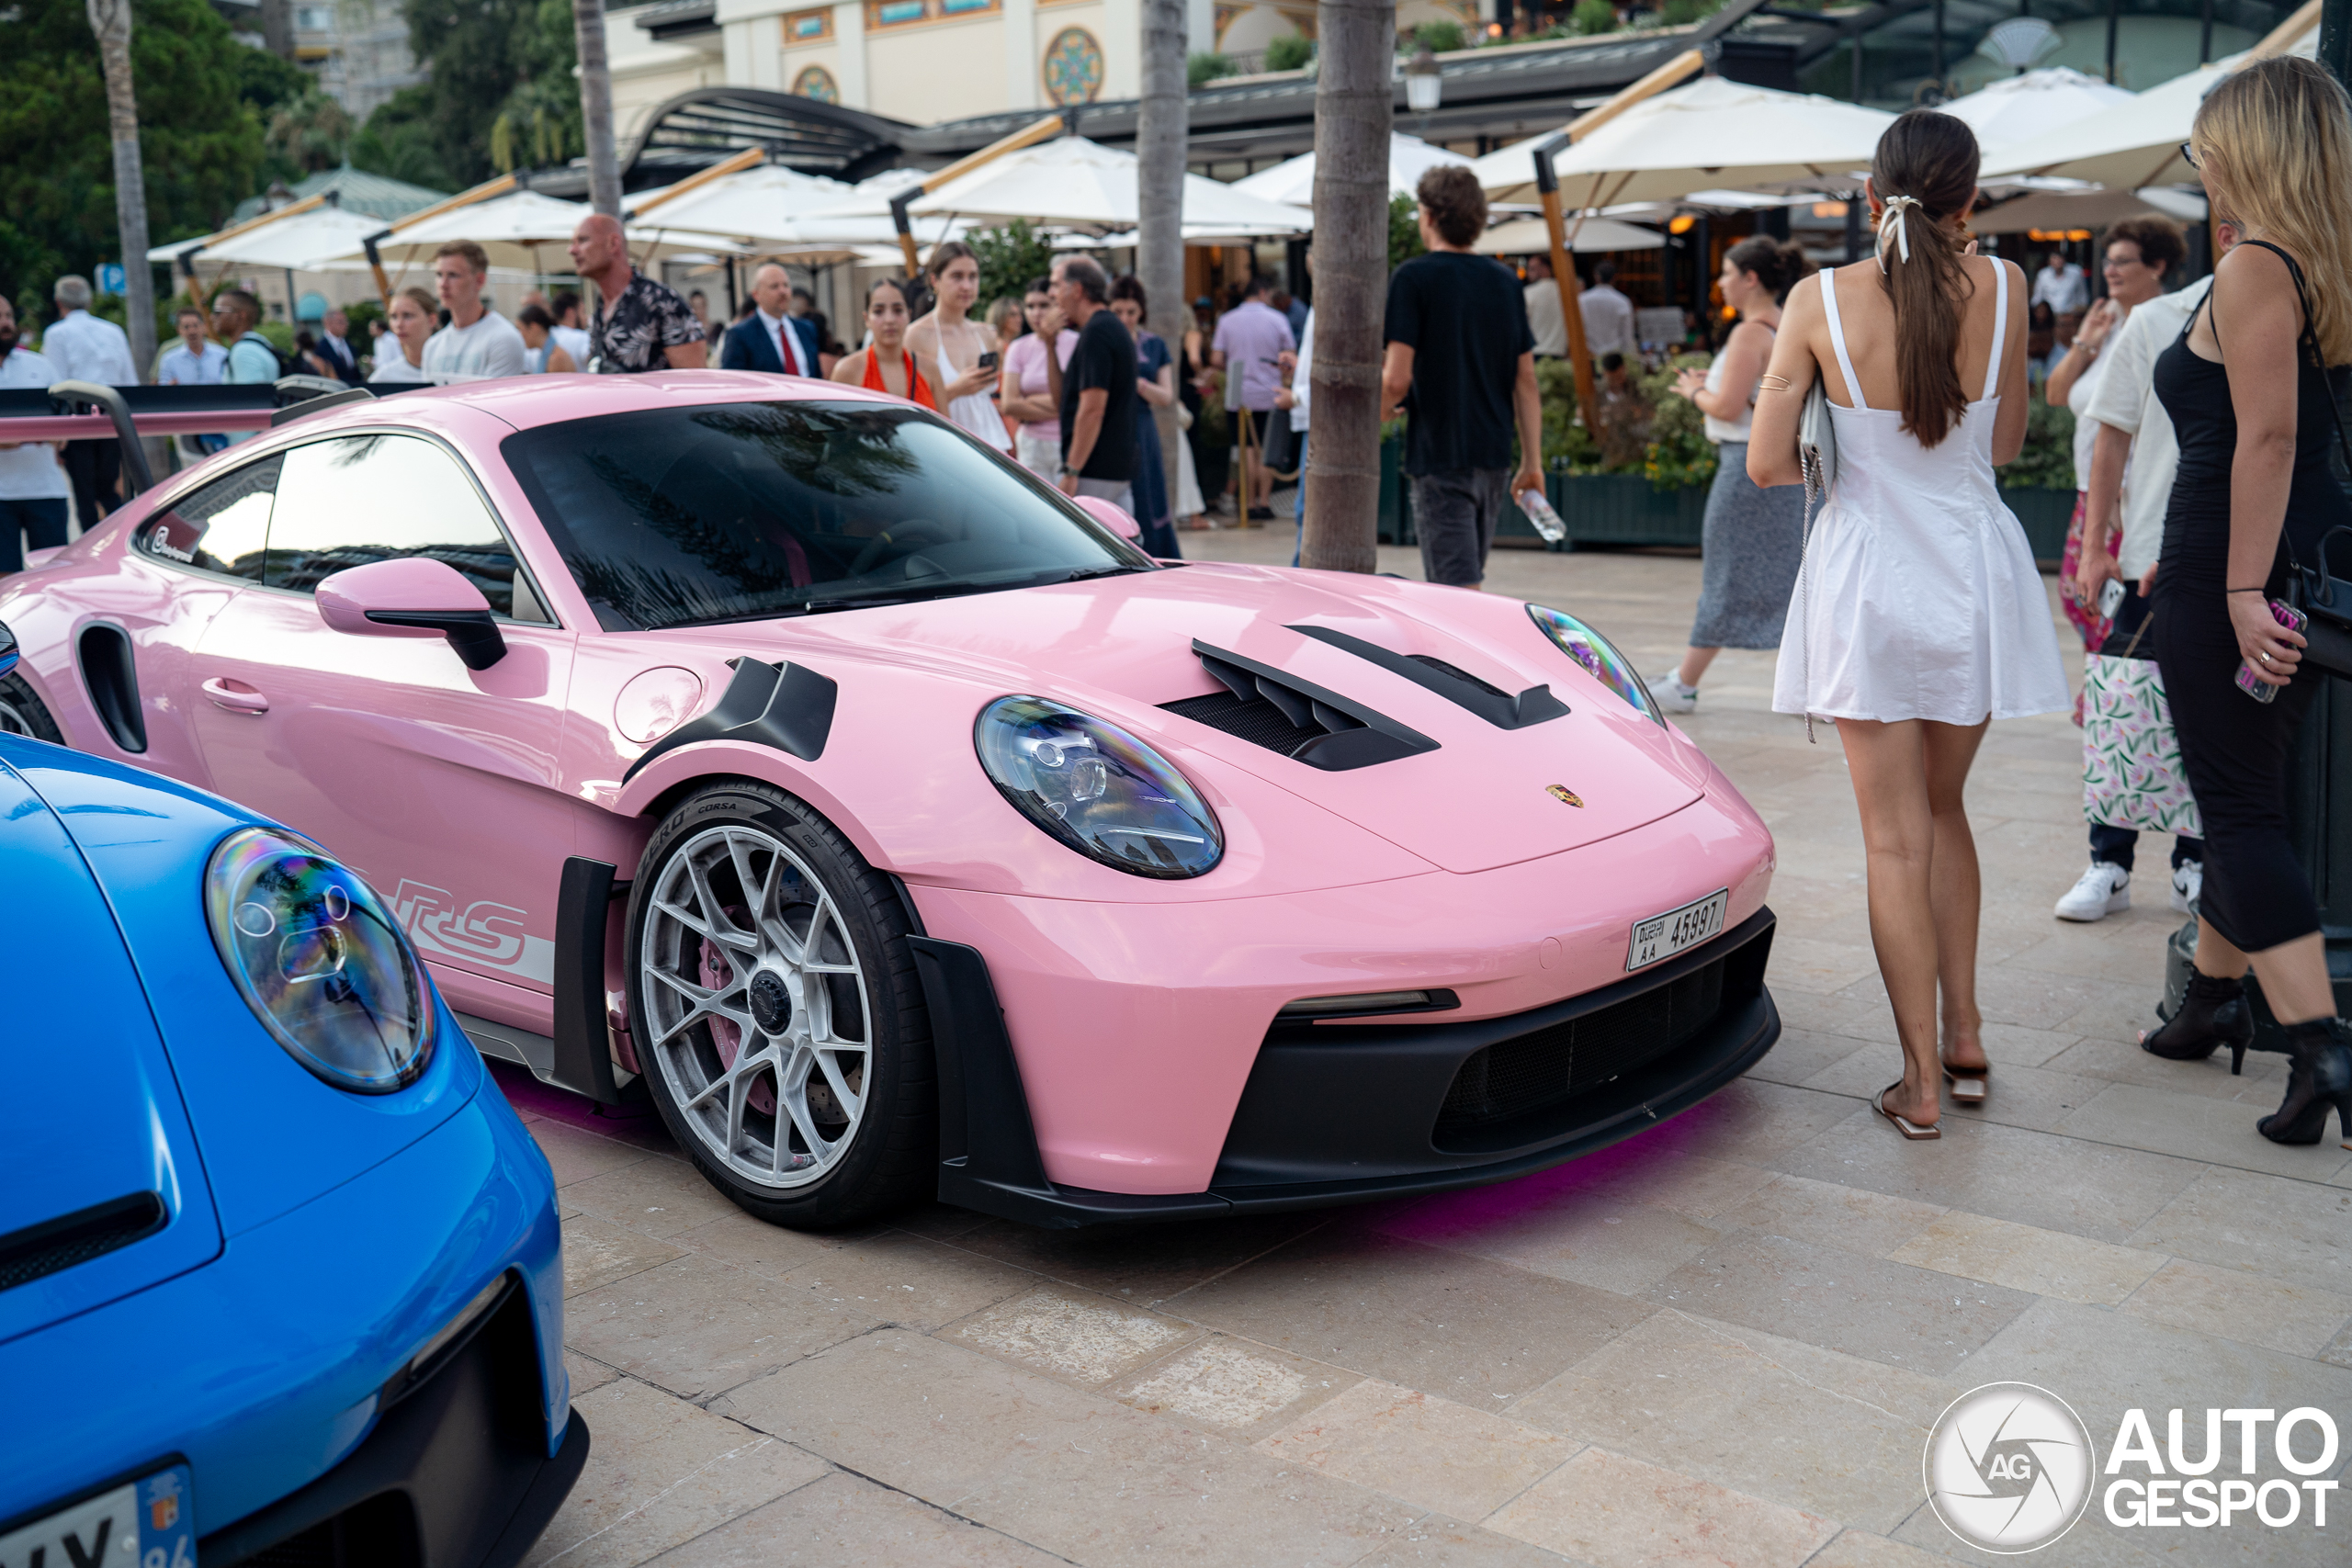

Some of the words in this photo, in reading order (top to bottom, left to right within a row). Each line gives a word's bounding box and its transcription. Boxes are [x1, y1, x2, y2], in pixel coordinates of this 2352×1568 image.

[640, 809, 685, 879] ZERO
[697, 802, 737, 814] CORSA
[395, 877, 529, 965] RS
[1670, 900, 1717, 948] 45997
[1639, 942, 1656, 964] AA
